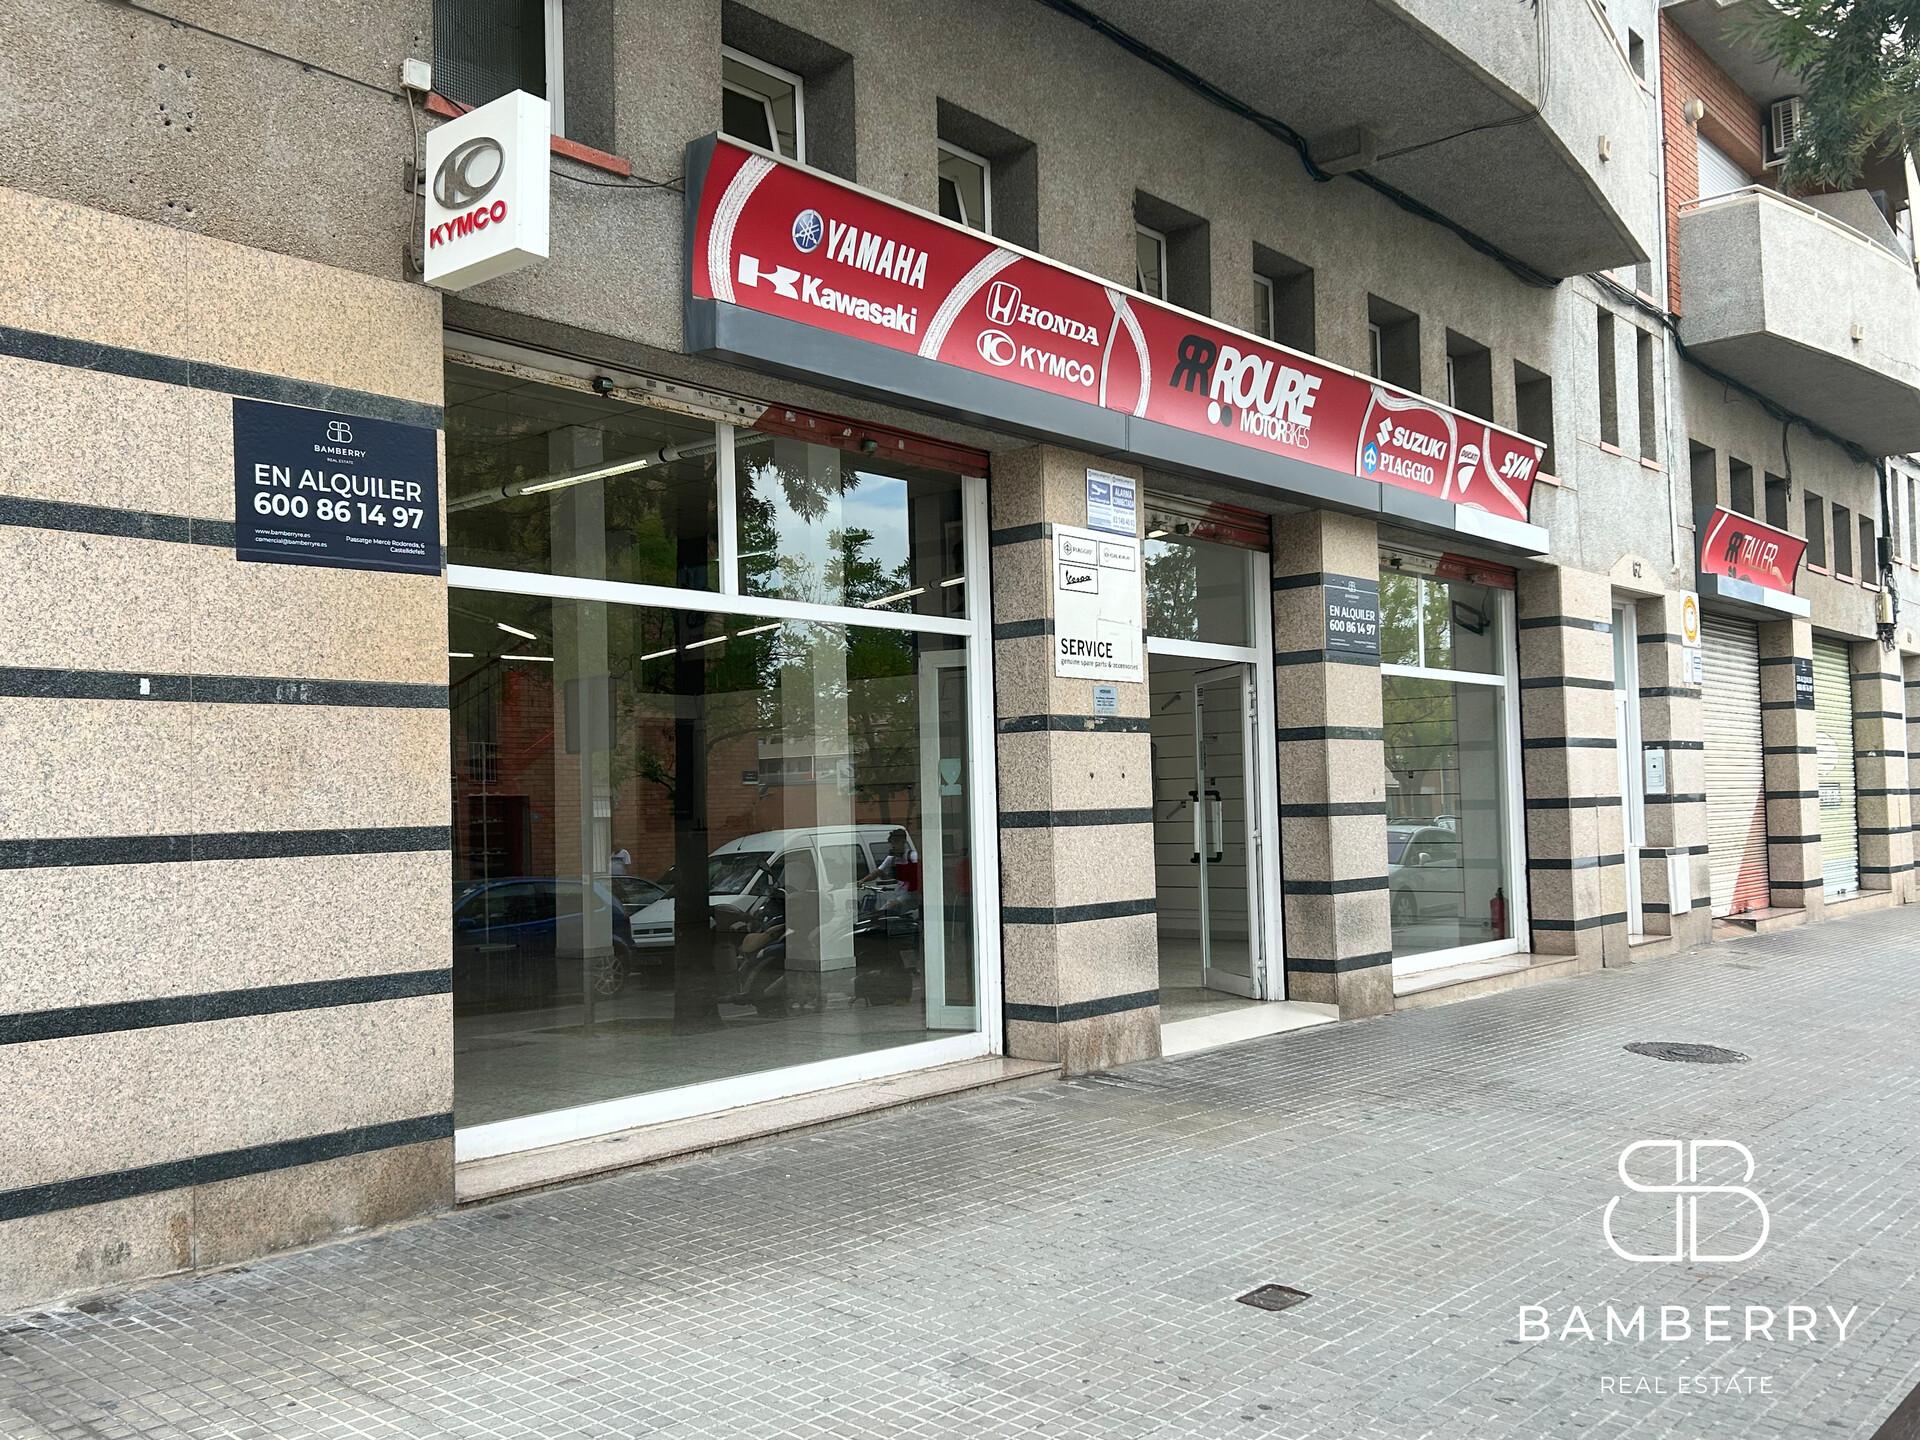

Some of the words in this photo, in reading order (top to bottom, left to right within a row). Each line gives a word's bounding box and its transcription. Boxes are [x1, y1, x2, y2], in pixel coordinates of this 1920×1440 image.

[430, 200, 507, 250] KYMCO
[825, 218, 929, 289] YAMAHA
[802, 274, 918, 336] Kawasaki
[1018, 303, 1100, 346] HONDA
[1020, 345, 1095, 388] KYMCO
[1209, 345, 1322, 426] ROURE
[314, 444, 366, 458] BAMBERRY
[1392, 426, 1447, 461] SUZUKI
[1461, 450, 1478, 461] DUCATI
[254, 464, 292, 488] EN
[298, 470, 422, 503] ALQUILER
[1380, 450, 1434, 486] PIAGGIO
[1499, 452, 1534, 481] SYM
[254, 492, 308, 519] 600
[316, 498, 351, 522] 86
[357, 503, 386, 526] 14
[392, 507, 424, 530] 97
[346, 536, 372, 544] Passatge
[1742, 534, 1778, 570] TALLER
[1330, 605, 1340, 616] EN
[1341, 607, 1375, 622] ALQUILER
[1330, 620, 1344, 631] 600
[1346, 622, 1356, 633] 86
[1356, 622, 1365, 634] 14
[1366, 624, 1376, 635] 97
[1061, 638, 1113, 658] SERVICE
[1061, 658, 1080, 666] genuine
